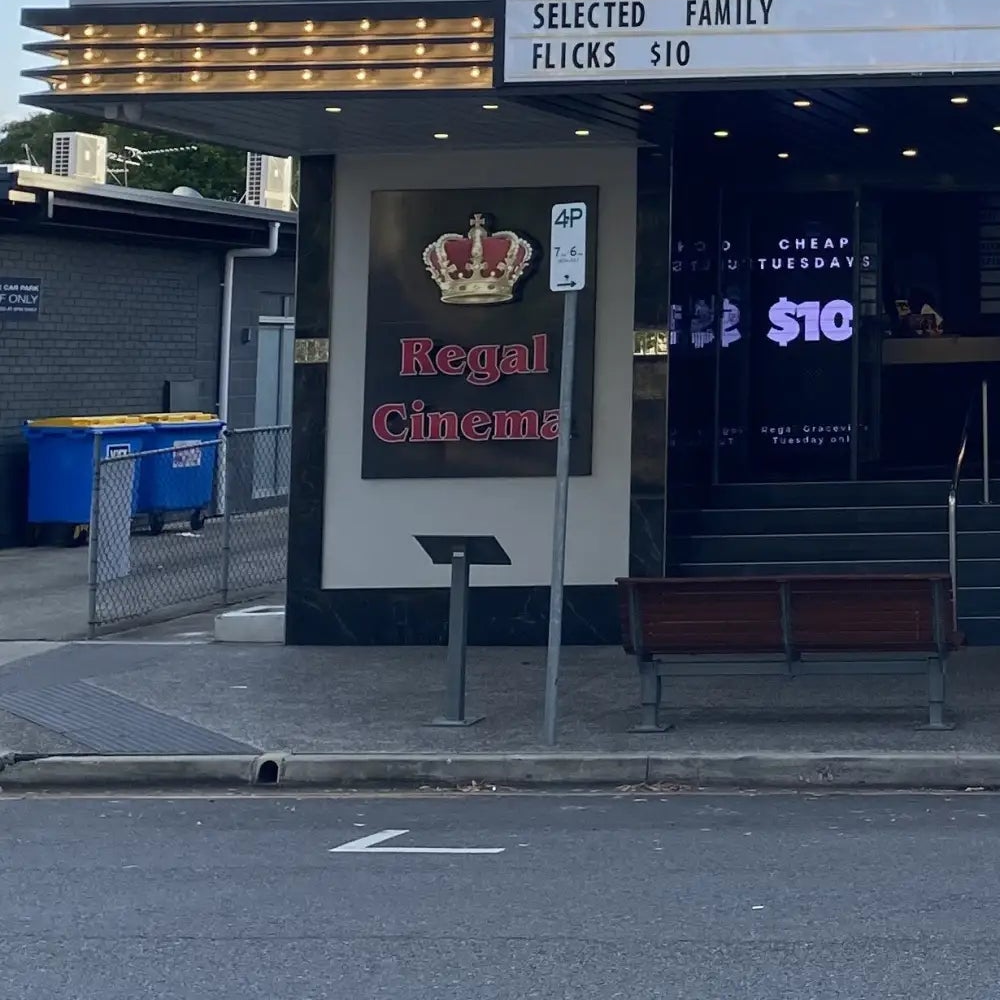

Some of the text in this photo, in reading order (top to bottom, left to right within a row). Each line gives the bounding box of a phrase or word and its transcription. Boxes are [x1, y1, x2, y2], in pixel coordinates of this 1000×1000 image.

[533, 1, 646, 29] SELECTED
[532, 40, 690, 69] FLICKS $10
[554, 207, 583, 228] 4P
[778, 237, 849, 250] CHEAP
[758, 255, 870, 271] TUESDAYS
[8, 293, 39, 304] ONLY
[766, 296, 854, 347] $10
[399, 334, 549, 386] Regal
[772, 435, 824, 445] Tuesday
